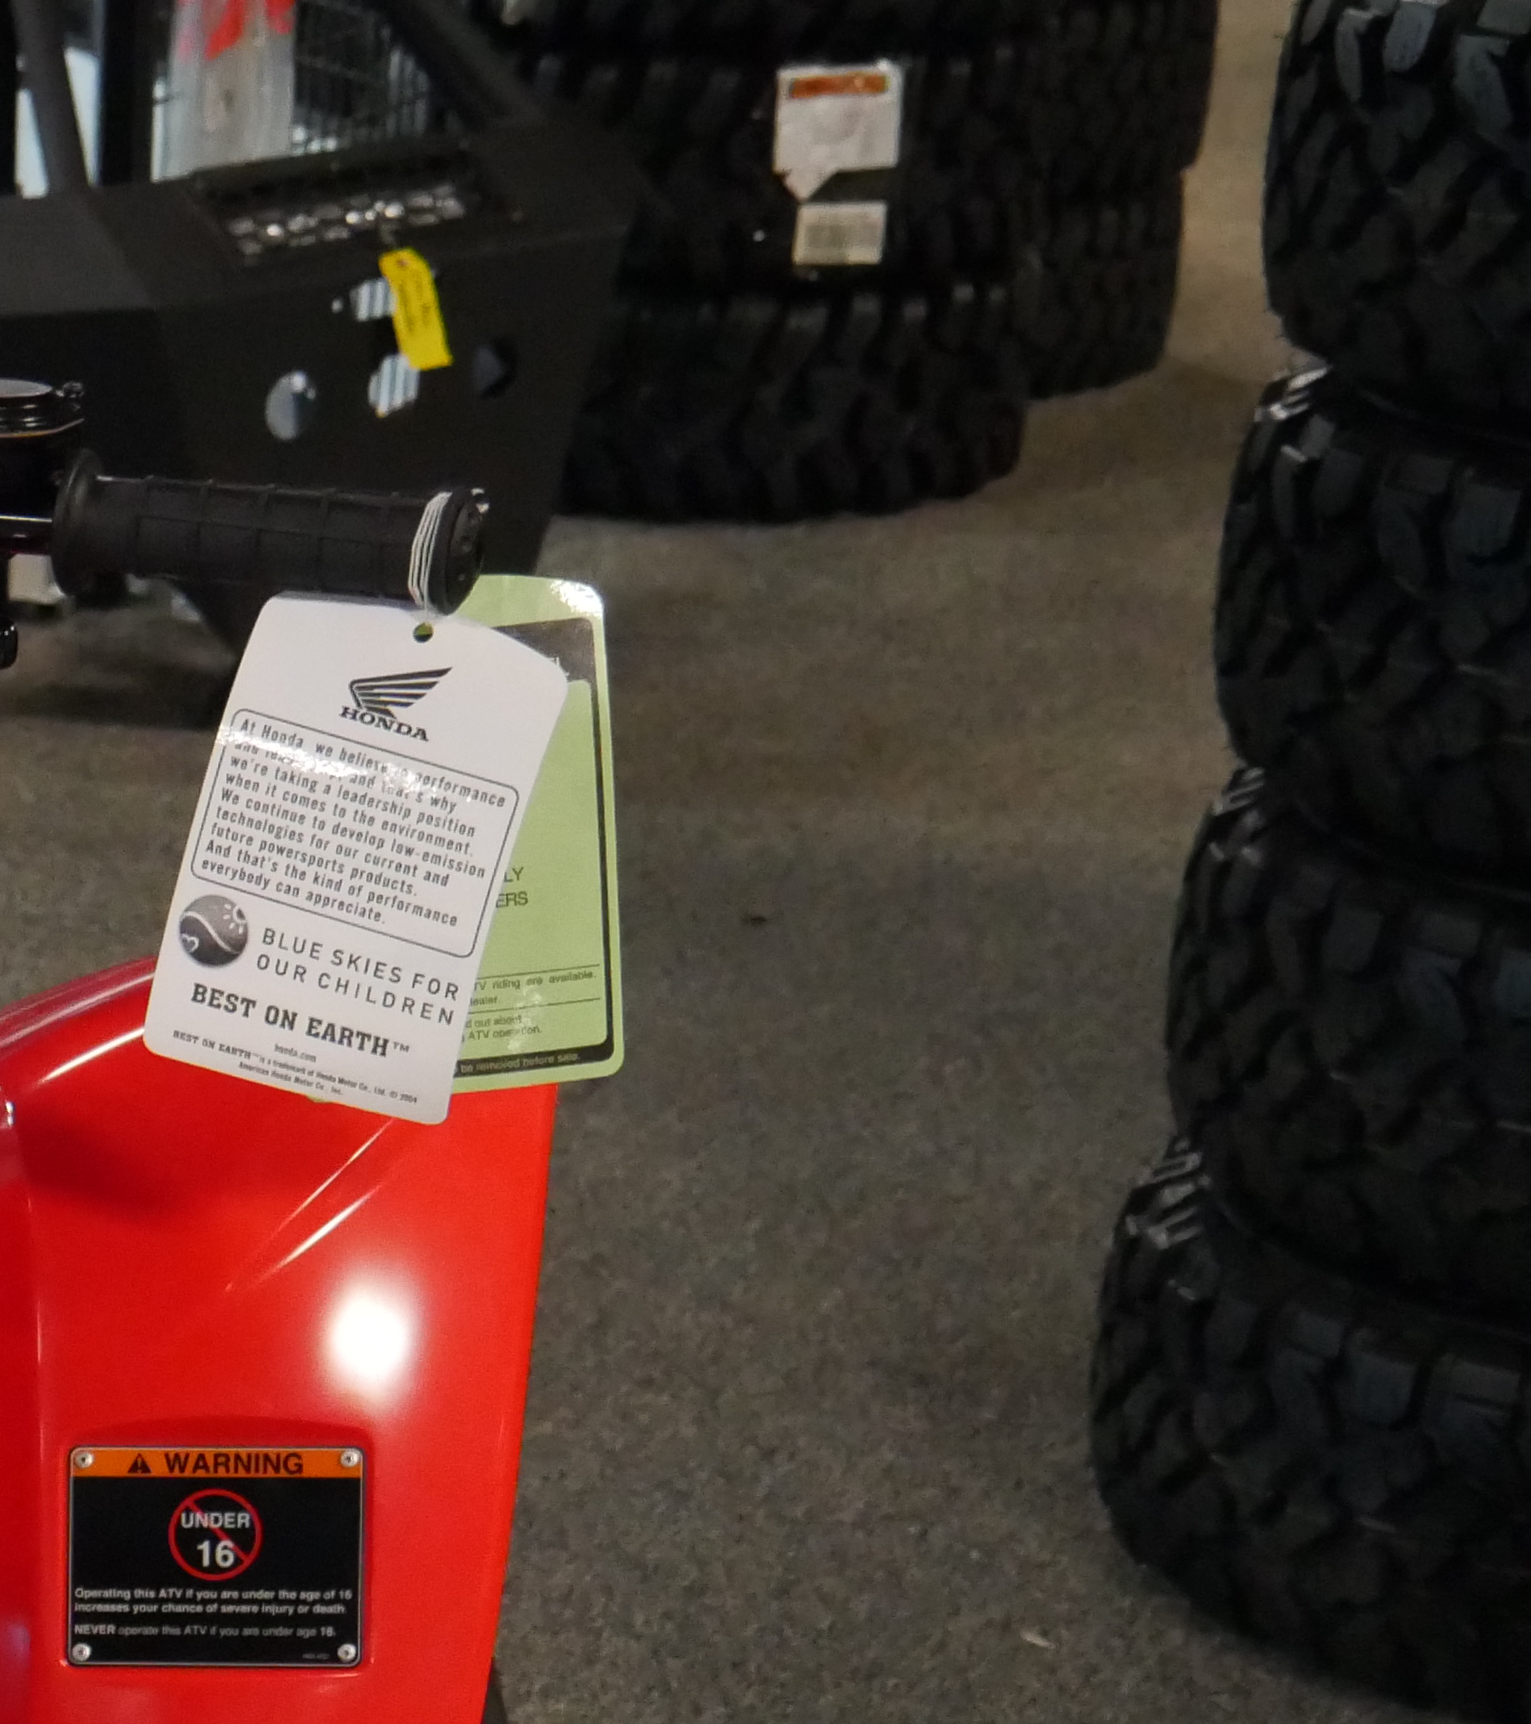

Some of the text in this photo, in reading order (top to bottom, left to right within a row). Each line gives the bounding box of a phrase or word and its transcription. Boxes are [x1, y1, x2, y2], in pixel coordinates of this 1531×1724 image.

[240, 719, 256, 736] At
[315, 741, 333, 758] we
[339, 747, 387, 773] believe
[339, 705, 429, 742] HONDA
[225, 773, 473, 857] when it comes to the environment.
[230, 756, 268, 776] we're
[274, 766, 319, 793] taking
[322, 784, 331, 795] a
[337, 785, 411, 819] leadership
[416, 811, 476, 837] position
[430, 795, 457, 815] why
[216, 806, 450, 887] technologies for our current and
[221, 787, 486, 878] We continue to develop low-emission
[205, 839, 458, 926] And that's the kind of performance
[211, 822, 417, 896] future powersports products.
[201, 859, 385, 925] everybody can appreciate.
[256, 953, 455, 1026] OUR CHILDREN
[262, 927, 459, 1001] BLUE SKIES FOR
[492, 978, 520, 990] riding
[548, 971, 596, 984] available.
[191, 982, 257, 1018] BEST
[264, 1004, 298, 1031] ON
[165, 1453, 303, 1475] WARNING
[180, 1512, 251, 1529] UNDER
[197, 1540, 235, 1568] 16
[74, 1587, 352, 1602] Operating this ATV if you are under the age of 16
[74, 1603, 130, 1613] increases
[132, 1604, 158, 1615] your
[161, 1603, 203, 1613] chance
[205, 1603, 218, 1613] of
[220, 1604, 259, 1614] severe
[261, 1603, 295, 1616] injury
[297, 1604, 310, 1614] or
[74, 1623, 116, 1635] NEVER
[161, 1625, 181, 1635] this
[184, 1625, 208, 1635] ATV
[219, 1627, 239, 1638] you
[241, 1627, 259, 1636] are
[262, 1626, 293, 1636] under
[296, 1627, 316, 1638] age
